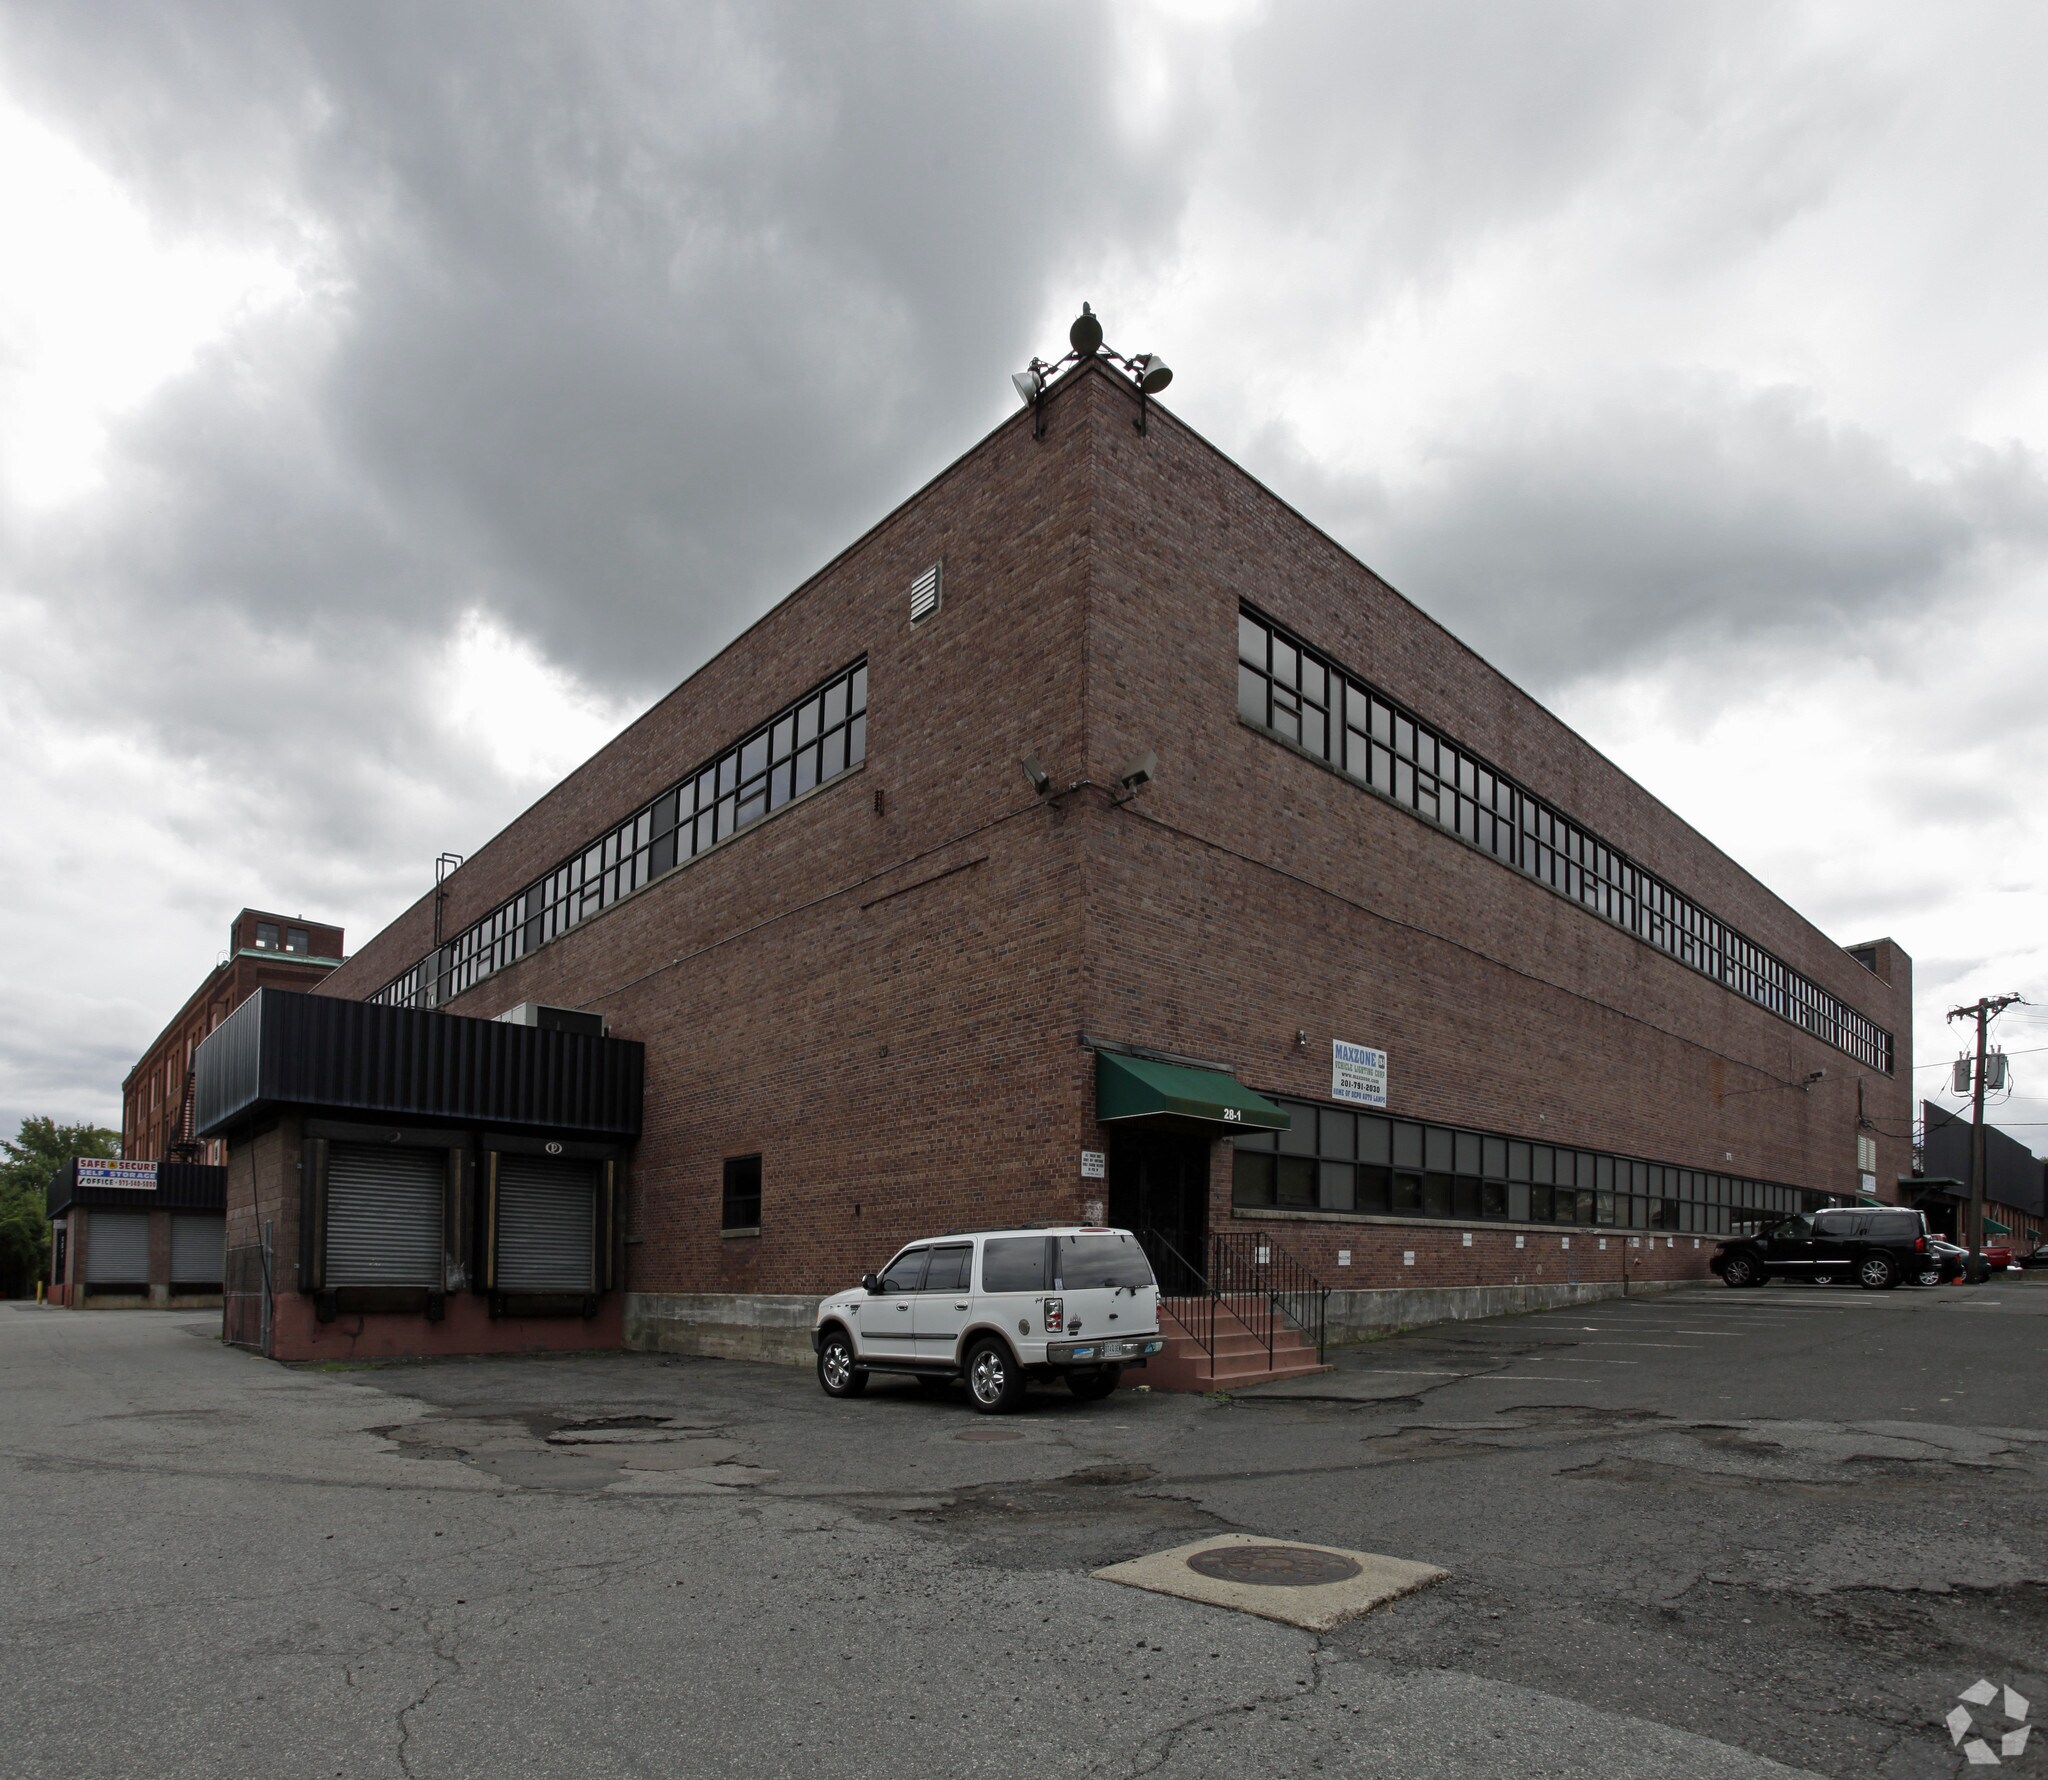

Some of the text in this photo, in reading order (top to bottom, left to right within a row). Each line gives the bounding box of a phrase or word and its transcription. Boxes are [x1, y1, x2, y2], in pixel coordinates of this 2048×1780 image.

[1335, 1044, 1376, 1067] MAXZONE
[1341, 1079, 1380, 1093] 201-791-2030
[1224, 1108, 1241, 1121] 28-1
[80, 1160, 106, 1168] SAFE
[119, 1161, 156, 1171] SECURE
